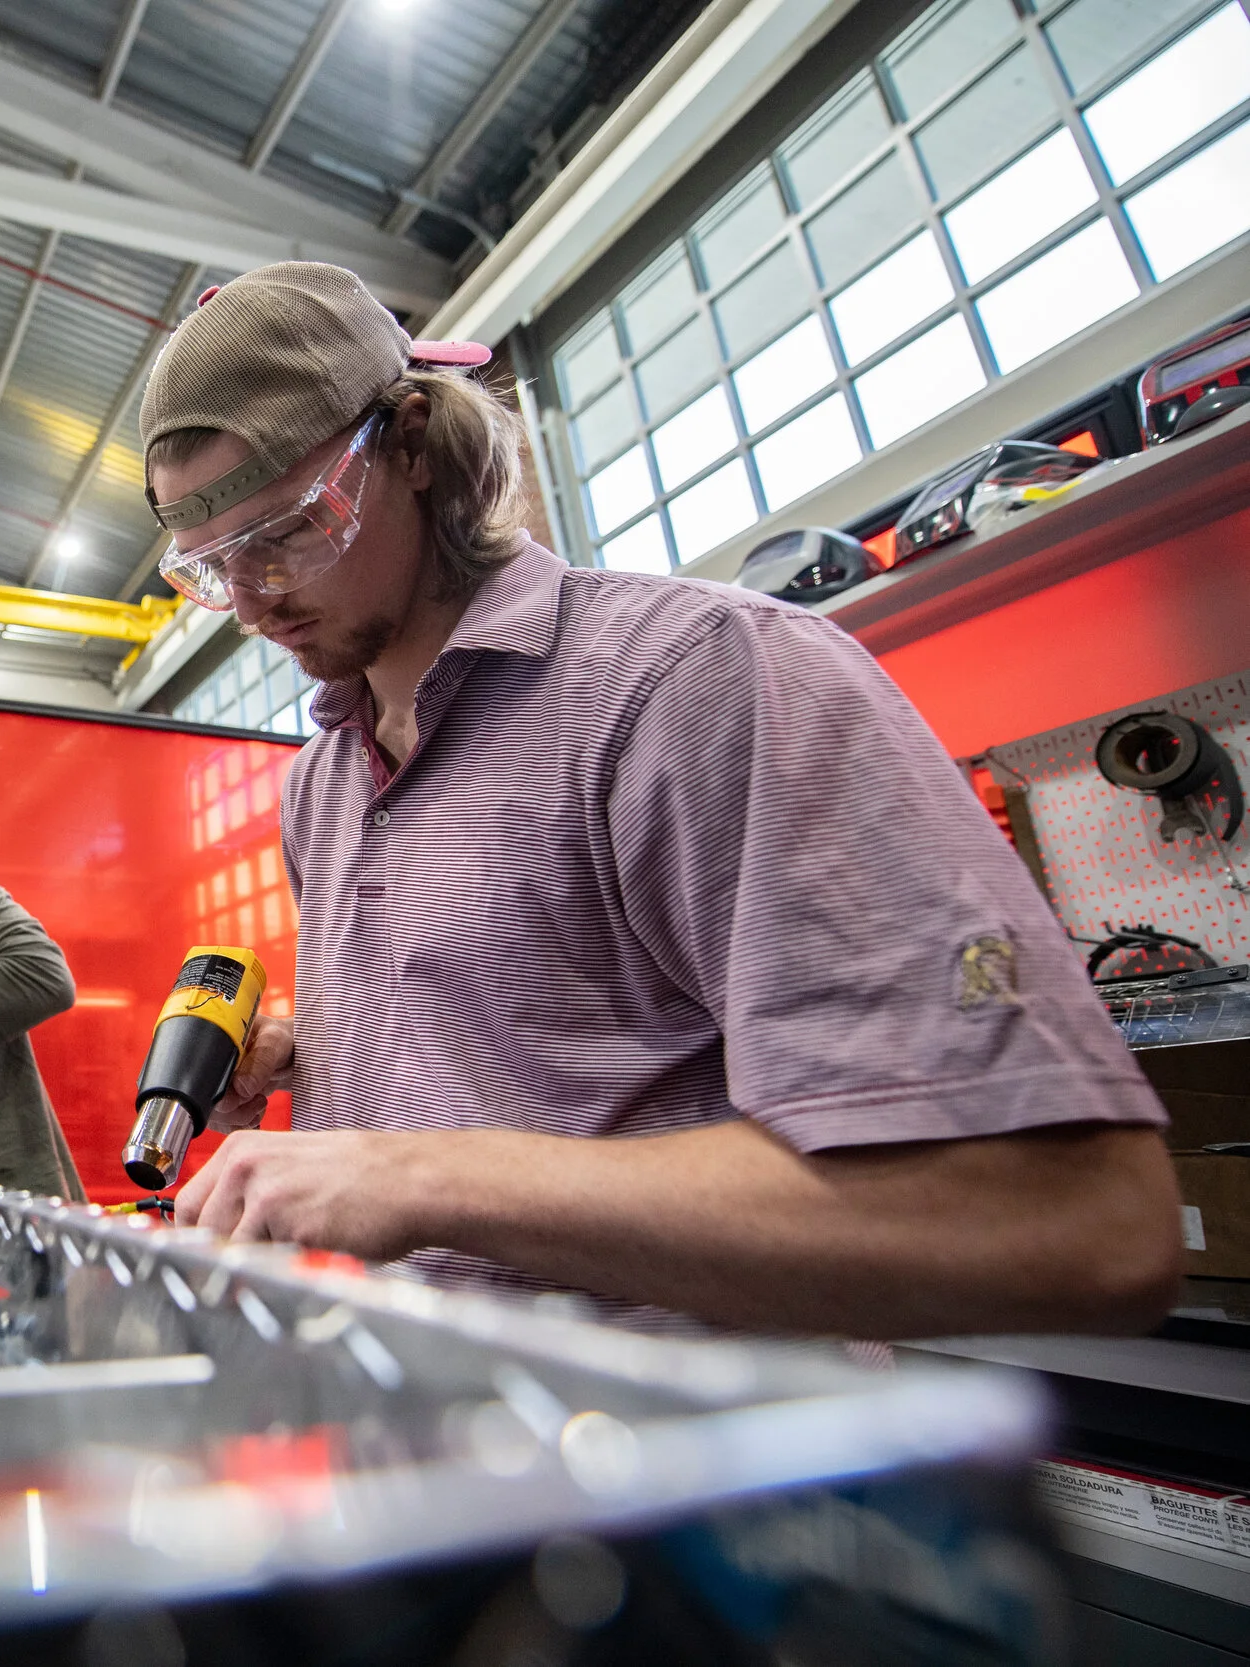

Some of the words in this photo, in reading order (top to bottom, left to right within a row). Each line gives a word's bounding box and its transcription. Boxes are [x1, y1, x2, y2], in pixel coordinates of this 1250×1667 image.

[1035, 1469, 1058, 1482] ARA
[1059, 1474, 1124, 1497] SOLDADURA
[1151, 1496, 1218, 1518] BAGUETTES
